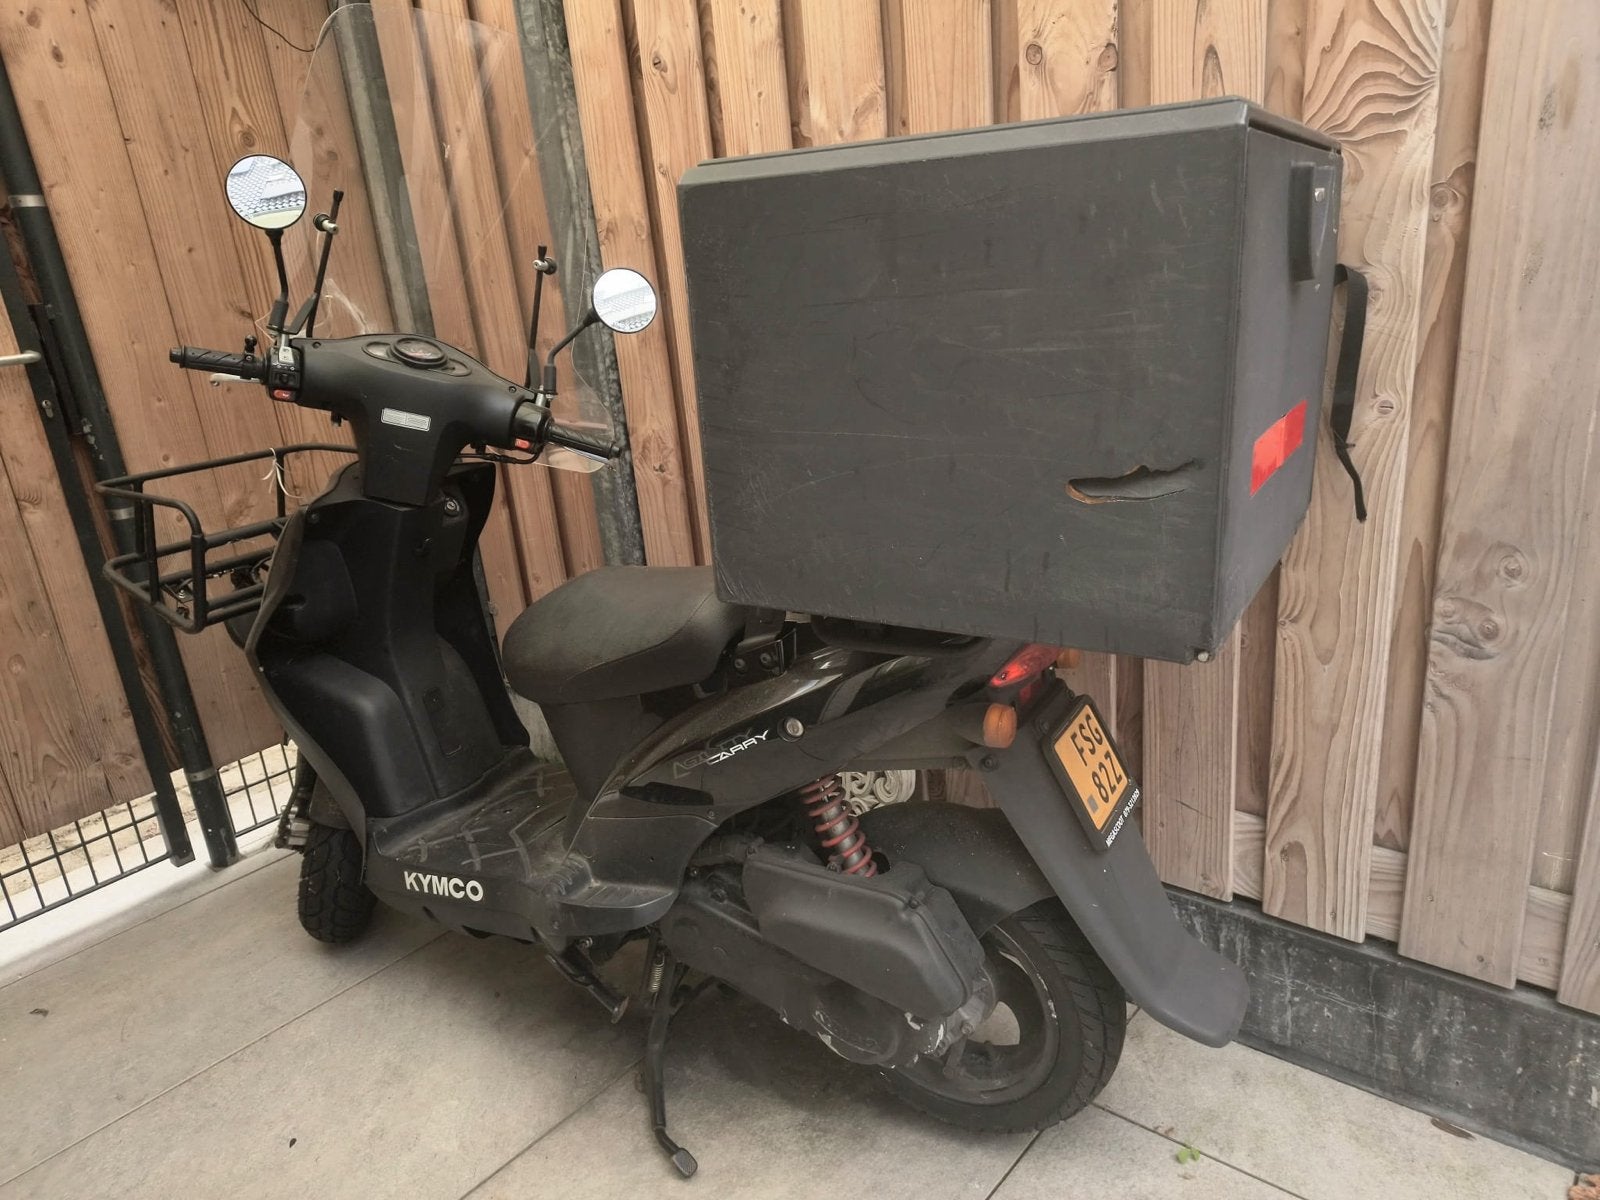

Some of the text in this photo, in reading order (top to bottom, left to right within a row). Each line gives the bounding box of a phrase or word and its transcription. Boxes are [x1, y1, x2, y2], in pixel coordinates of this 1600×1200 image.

[706, 730, 769, 766] CARRY
[1070, 714, 1103, 767] FSG
[1091, 750, 1123, 804] 82Z
[403, 870, 484, 902] KYMCO
